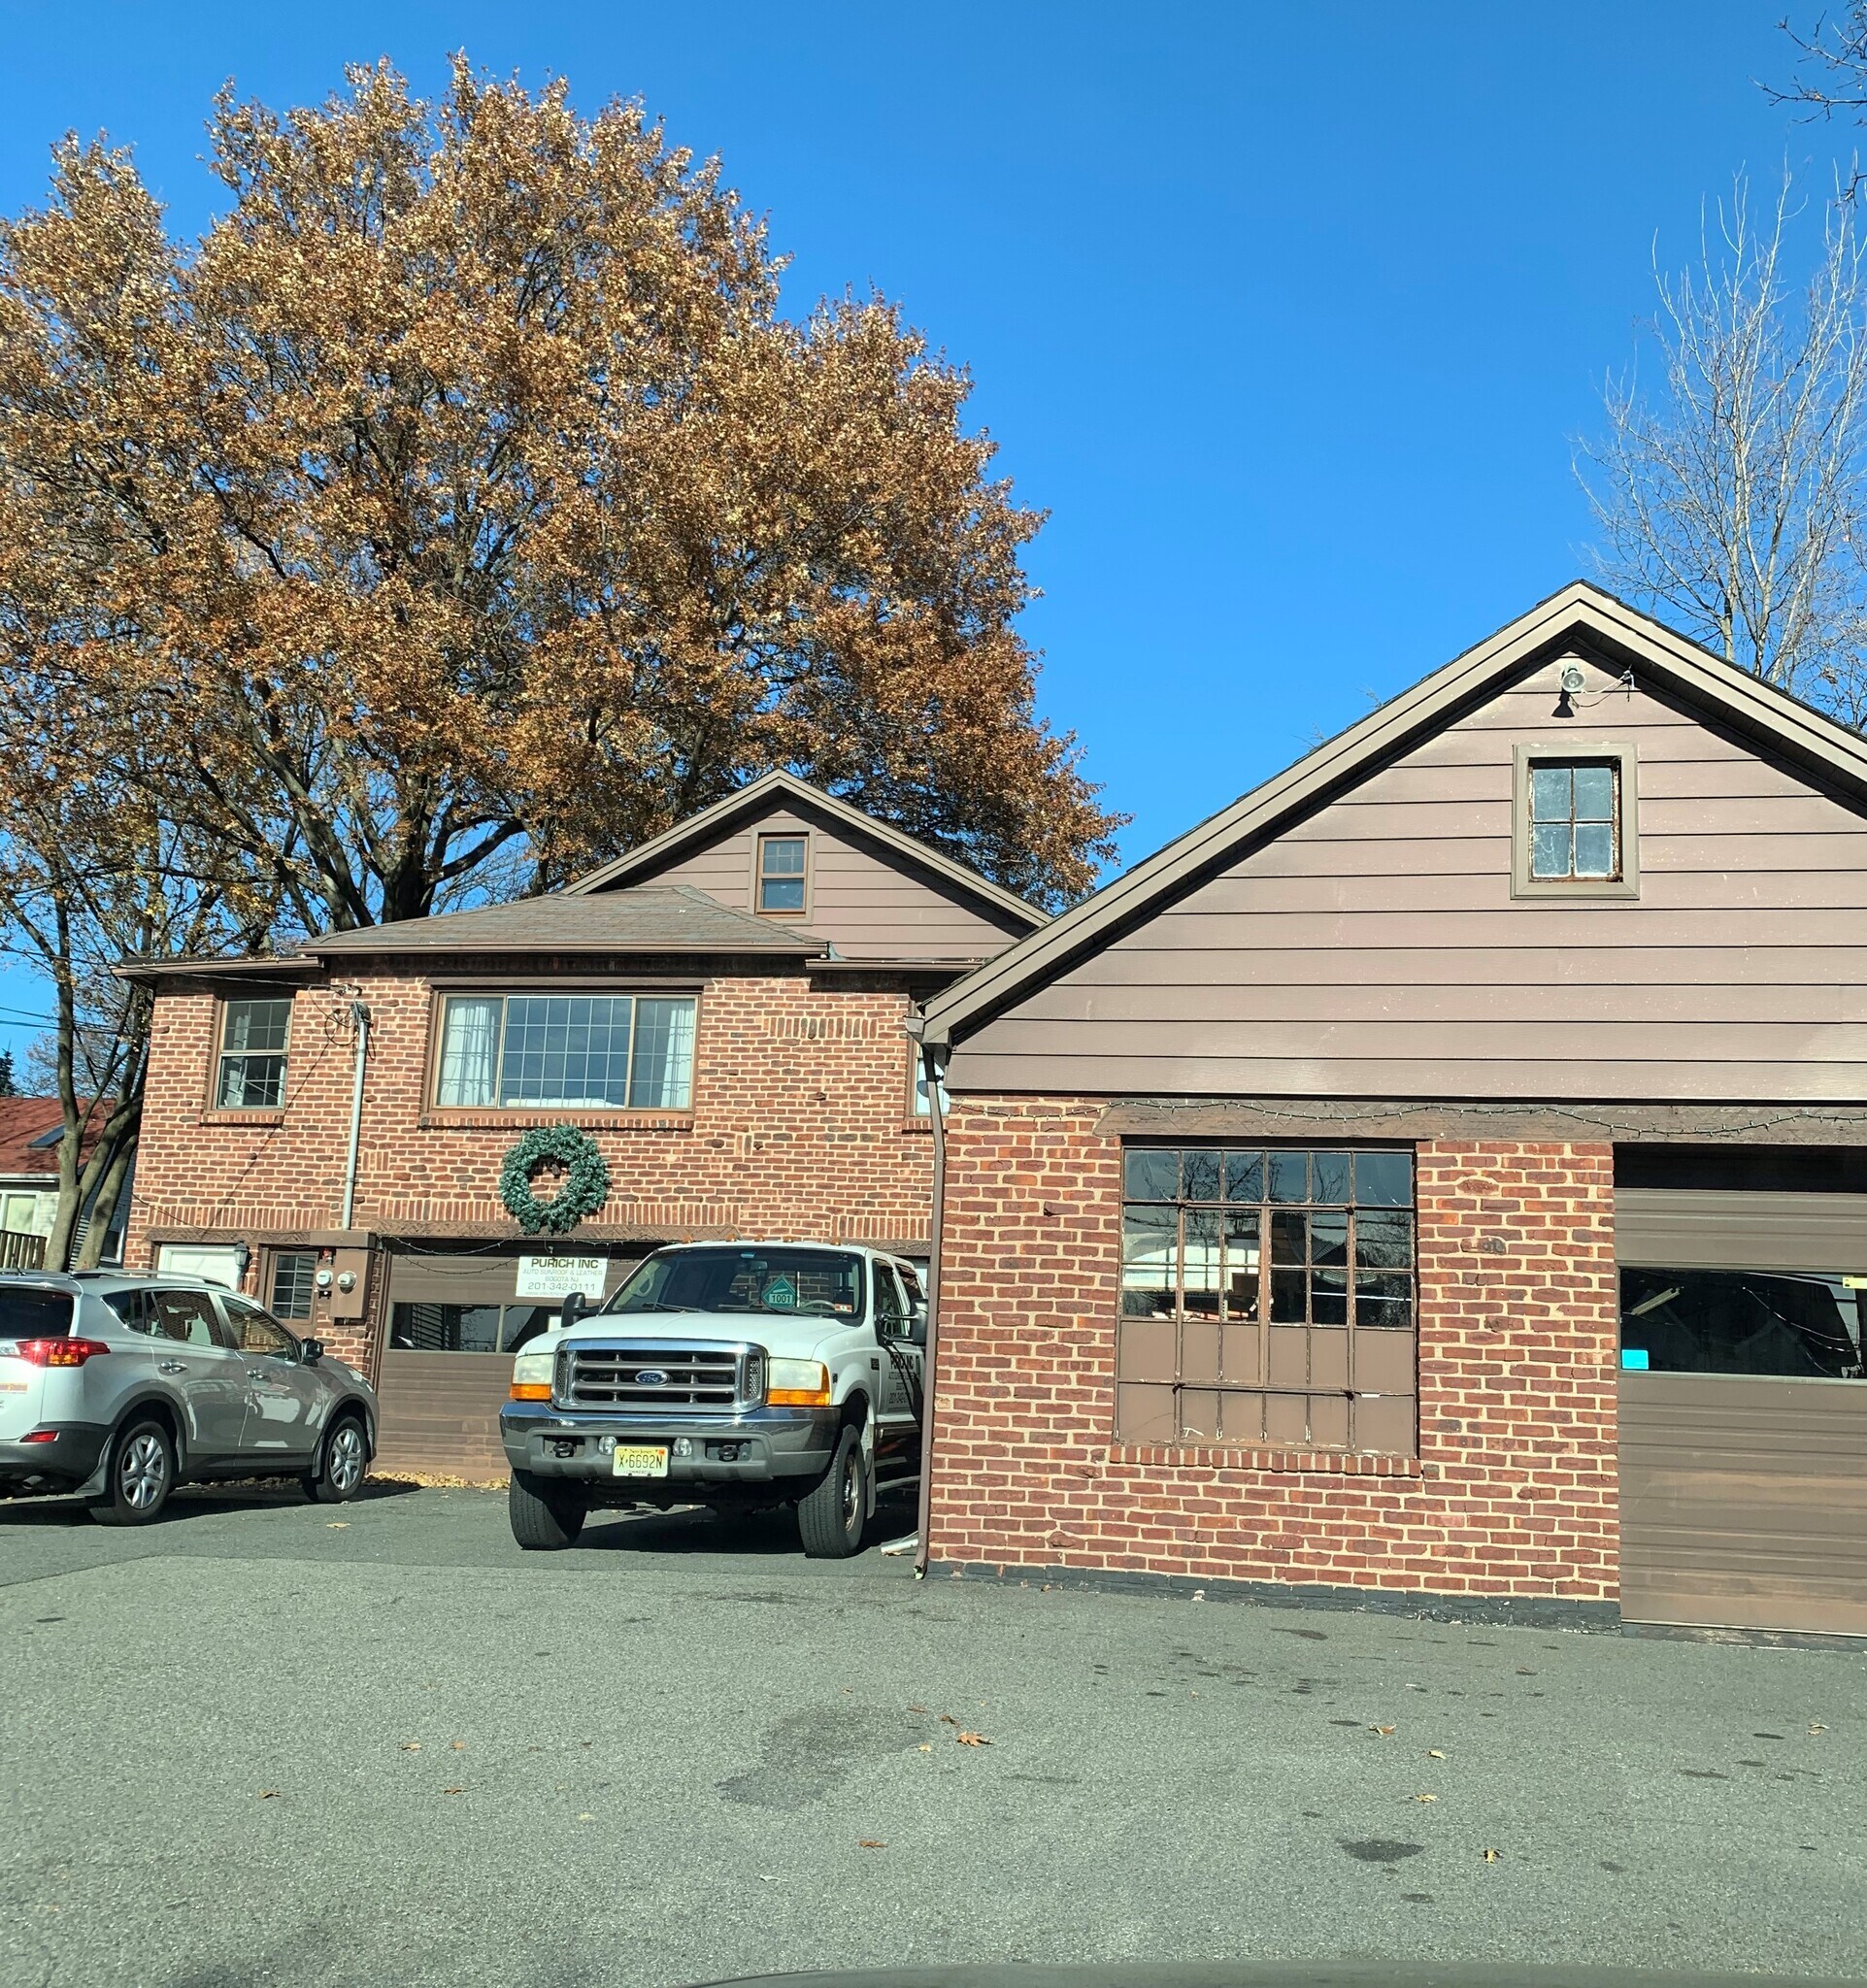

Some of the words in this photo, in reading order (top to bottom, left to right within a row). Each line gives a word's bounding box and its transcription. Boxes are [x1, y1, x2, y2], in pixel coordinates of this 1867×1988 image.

[531, 1258, 575, 1269] PURICH
[578, 1259, 599, 1269] INC
[527, 1282, 595, 1291] 201-342-0111
[772, 1295, 791, 1304] 1001
